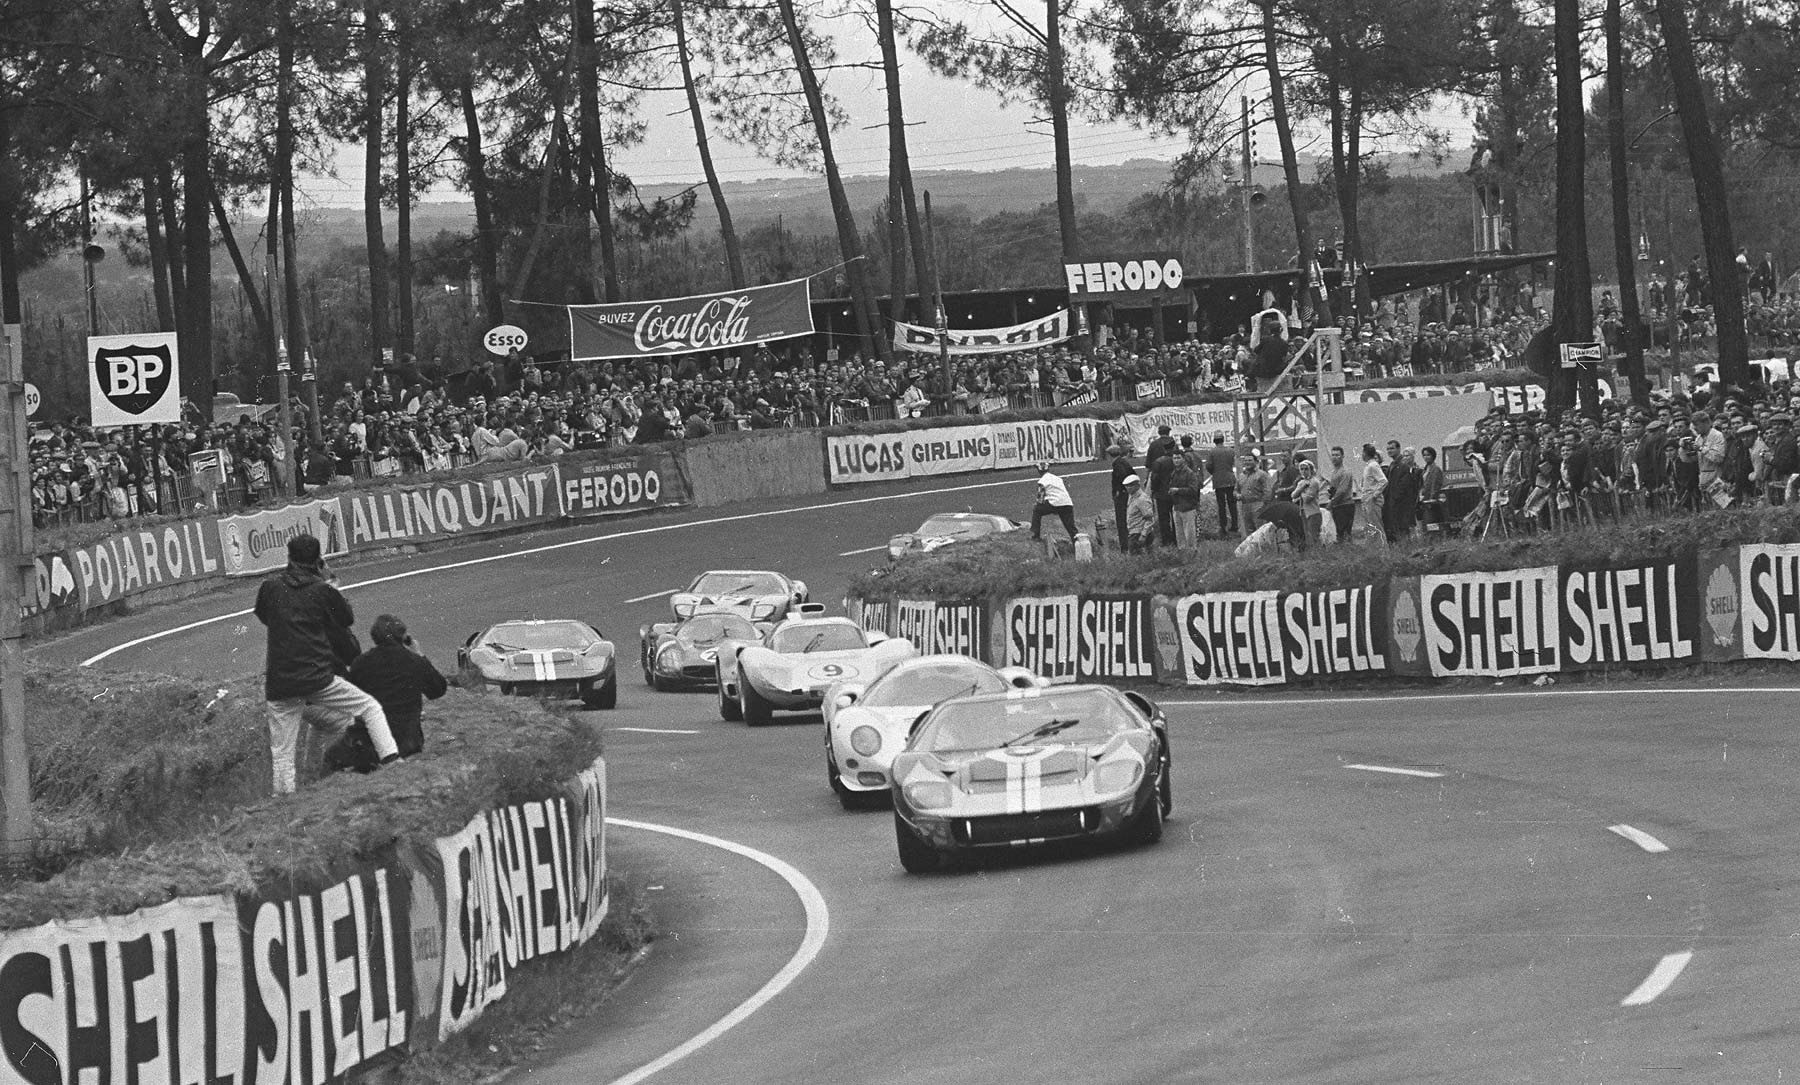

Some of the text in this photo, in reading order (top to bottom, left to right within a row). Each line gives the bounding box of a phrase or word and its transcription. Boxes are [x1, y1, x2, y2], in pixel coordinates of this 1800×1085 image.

[1064, 258, 1183, 294] FERODO
[598, 312, 636, 325] BUVEZ
[634, 295, 753, 352] Coca-Cola
[104, 354, 164, 397] BP
[1197, 412, 1207, 425] DE
[834, 440, 905, 475] LUCAS
[911, 436, 992, 465] GIRLING
[352, 472, 548, 544] ALLINQUANT
[566, 470, 660, 511] FERODO
[1397, 618, 1418, 635] SHELL
[1430, 564, 1692, 671] SHELL SHELL
[1711, 596, 1735, 615] SHELL
[936, 606, 981, 662] SHELL
[1011, 600, 1152, 677] SHELL SHELL
[1186, 584, 1386, 681] SHELL SHELL
[823, 664, 844, 677] 9
[253, 868, 406, 1085] SHELL
[0, 921, 236, 1085] SHELL
